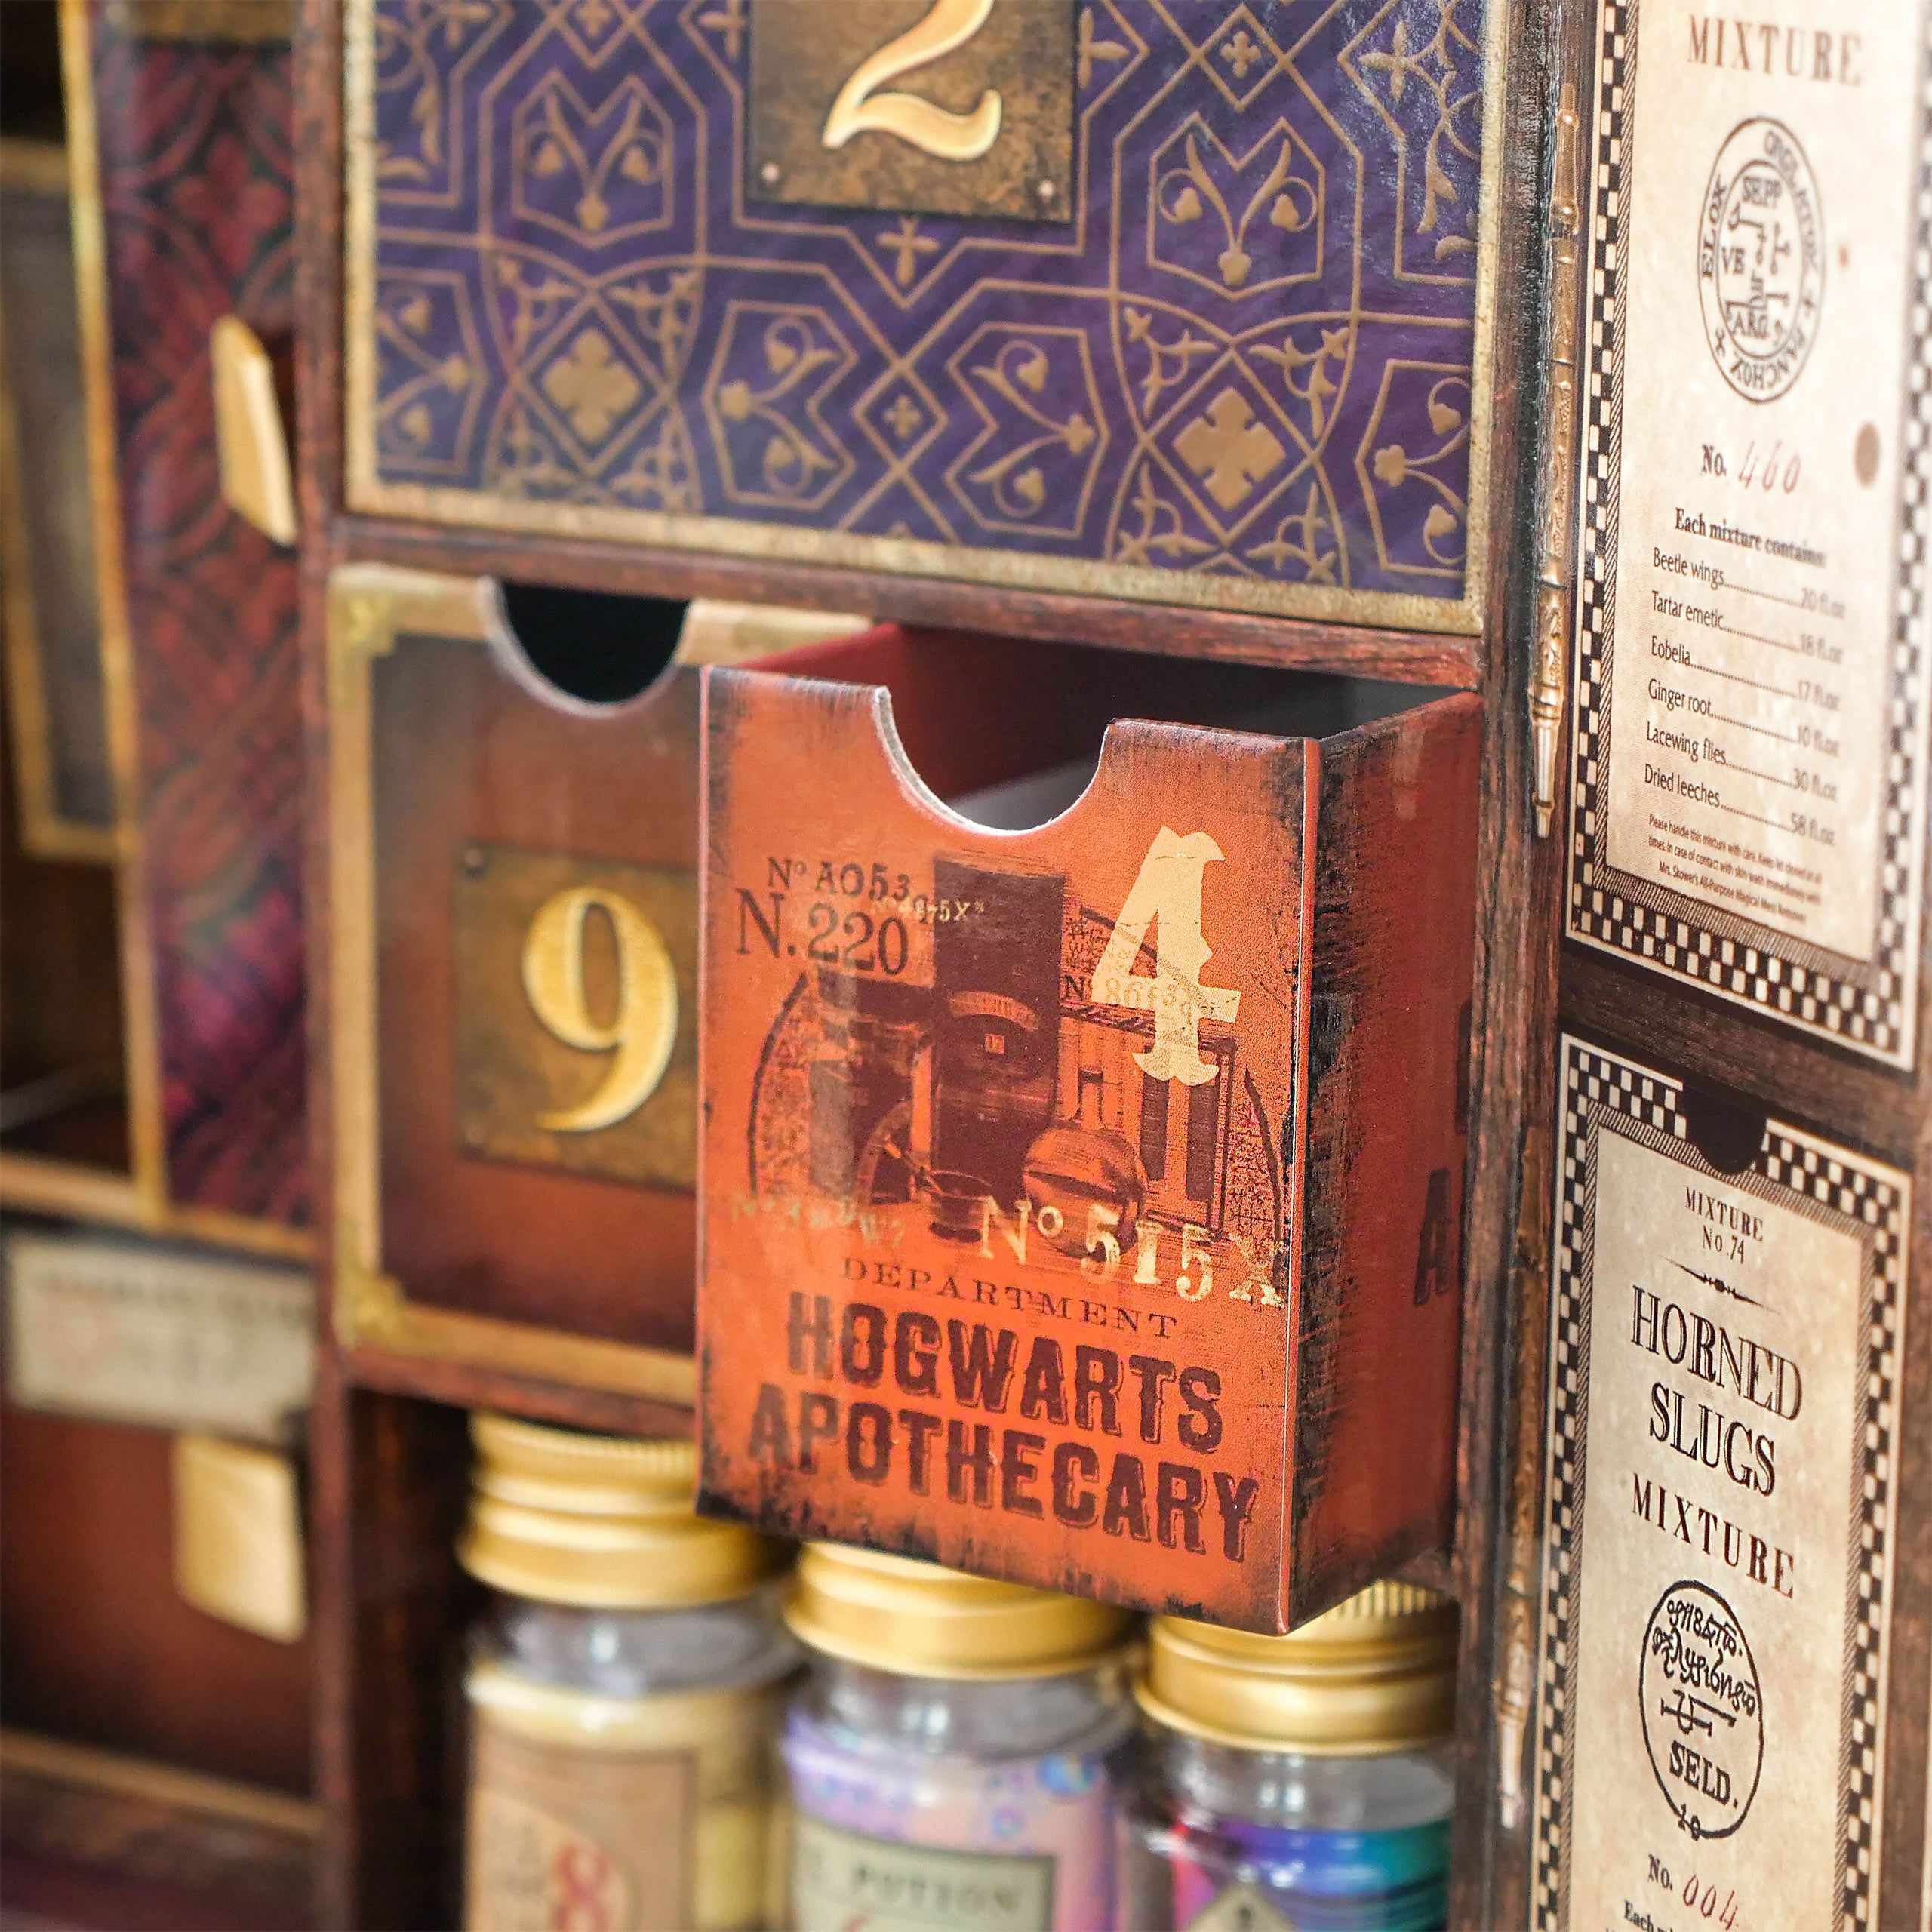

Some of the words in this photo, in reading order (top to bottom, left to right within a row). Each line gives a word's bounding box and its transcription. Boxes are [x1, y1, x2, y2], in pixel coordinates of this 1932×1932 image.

[822, 0, 1002, 162] 2
[1687, 14, 1862, 86] MIXTURE
[1653, 546, 1688, 576] Beetle
[1675, 507, 1706, 537] Each
[1709, 518, 1762, 552] mixture
[1651, 590, 1684, 617] Tartar
[1648, 678, 1684, 712] Ginger
[1647, 720, 1699, 763] Lacewing
[1644, 763, 1674, 792] Dried
[1677, 774, 1721, 808] leeches
[1091, 825, 1241, 1087] 4
[521, 886, 680, 1133] 9
[1685, 1186, 1764, 1242] MIXTURE
[841, 1257, 1179, 1339] DEPARTMENT
[786, 1291, 1223, 1456] HOGWARTS
[1630, 1284, 1803, 1421] HORNED
[746, 1383, 1259, 1564] APOTHECARY
[1649, 1382, 1776, 1497] SLUGS
[1631, 1472, 1795, 1599] MIXTURE
[1648, 1854, 1673, 1890] No.
